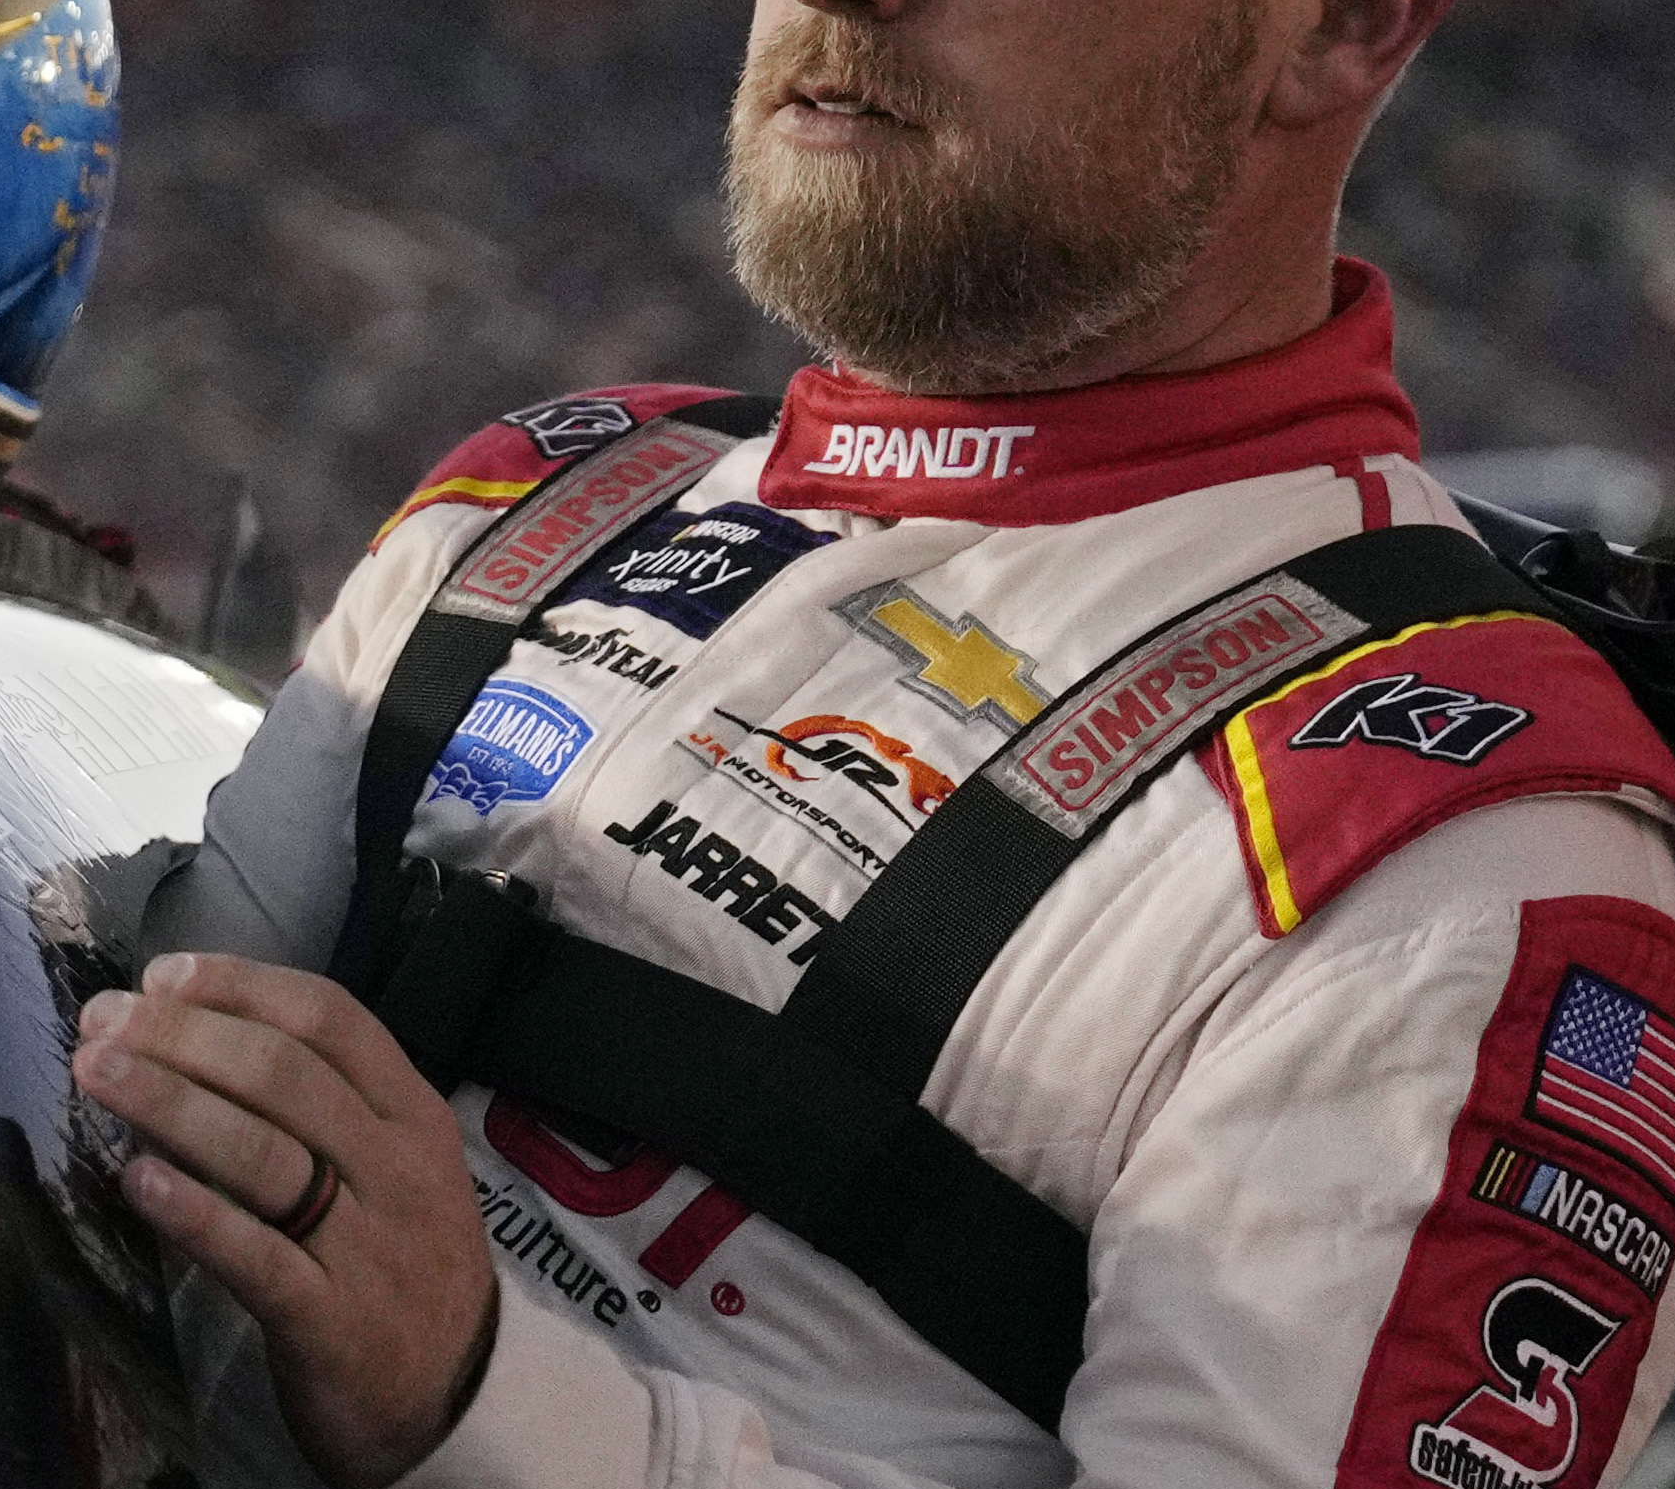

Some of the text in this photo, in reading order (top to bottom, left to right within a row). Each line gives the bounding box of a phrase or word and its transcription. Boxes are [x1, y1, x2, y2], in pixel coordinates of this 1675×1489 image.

[483, 439, 692, 592] SIMPSON
[1047, 604, 1293, 791] SIMPSON
[1539, 1168, 1672, 1293] NASCAR
